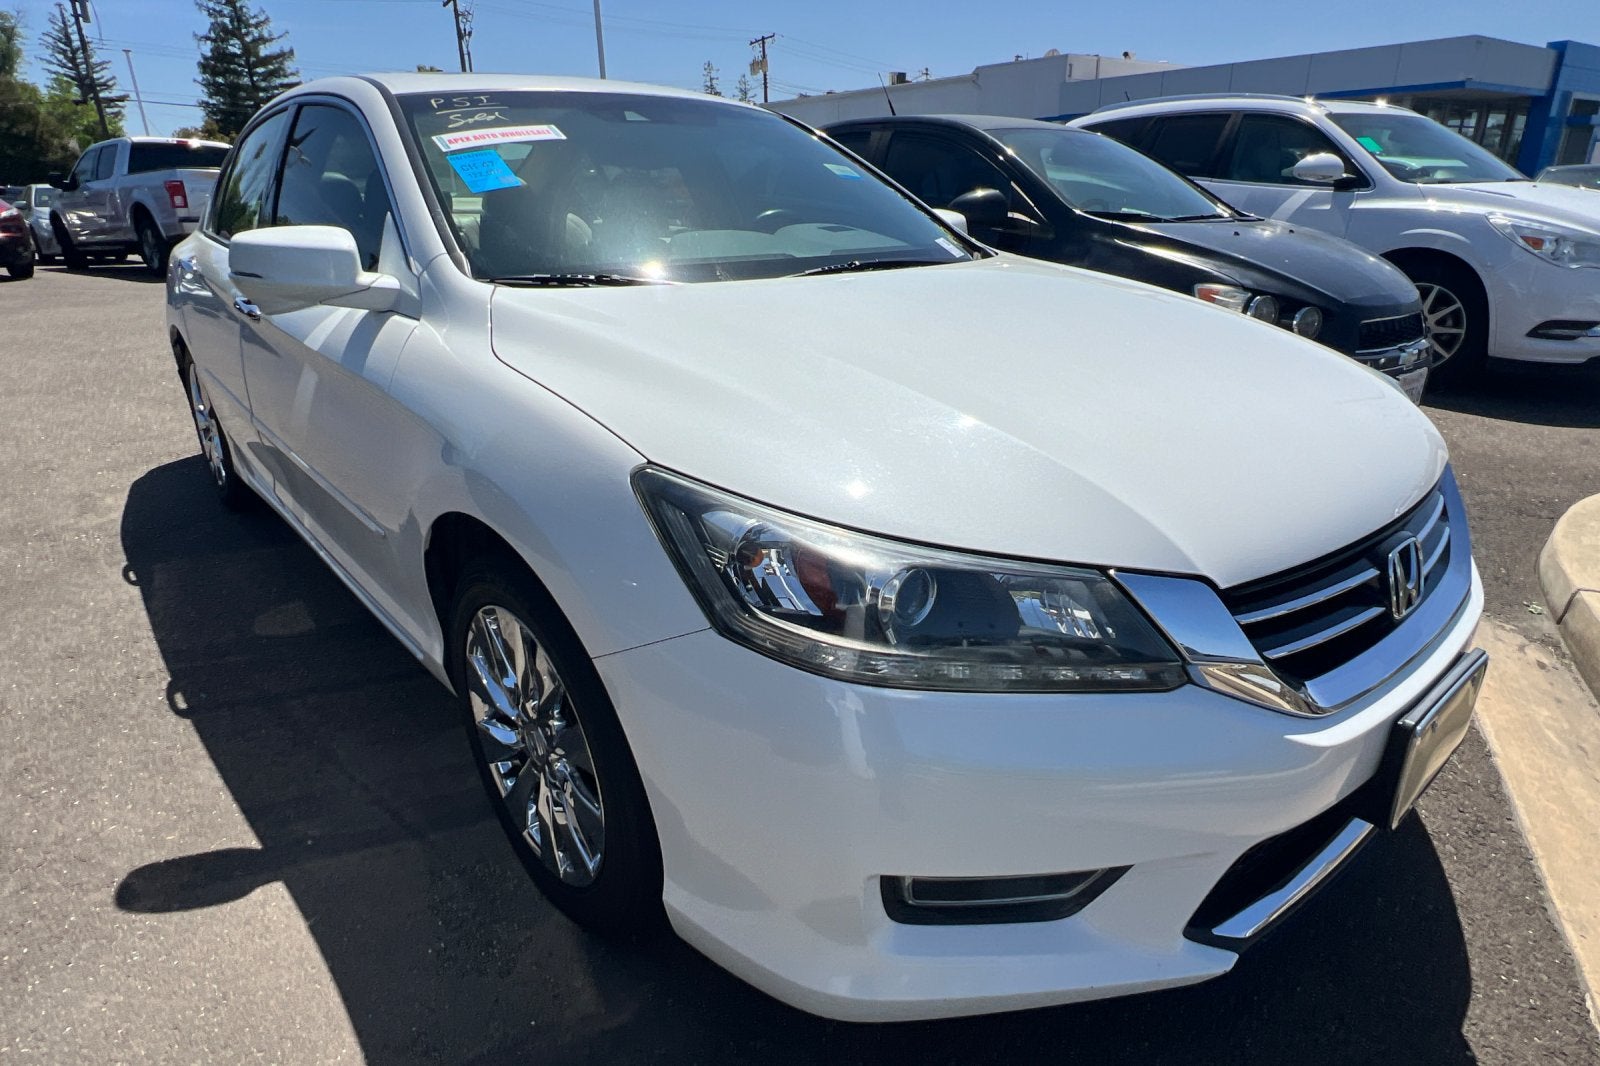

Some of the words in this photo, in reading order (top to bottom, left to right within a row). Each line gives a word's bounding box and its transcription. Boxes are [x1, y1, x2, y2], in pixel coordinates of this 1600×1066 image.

[447, 136, 473, 145] APEX
[473, 133, 497, 142] AUTO
[498, 129, 552, 138] WHOLESALE
